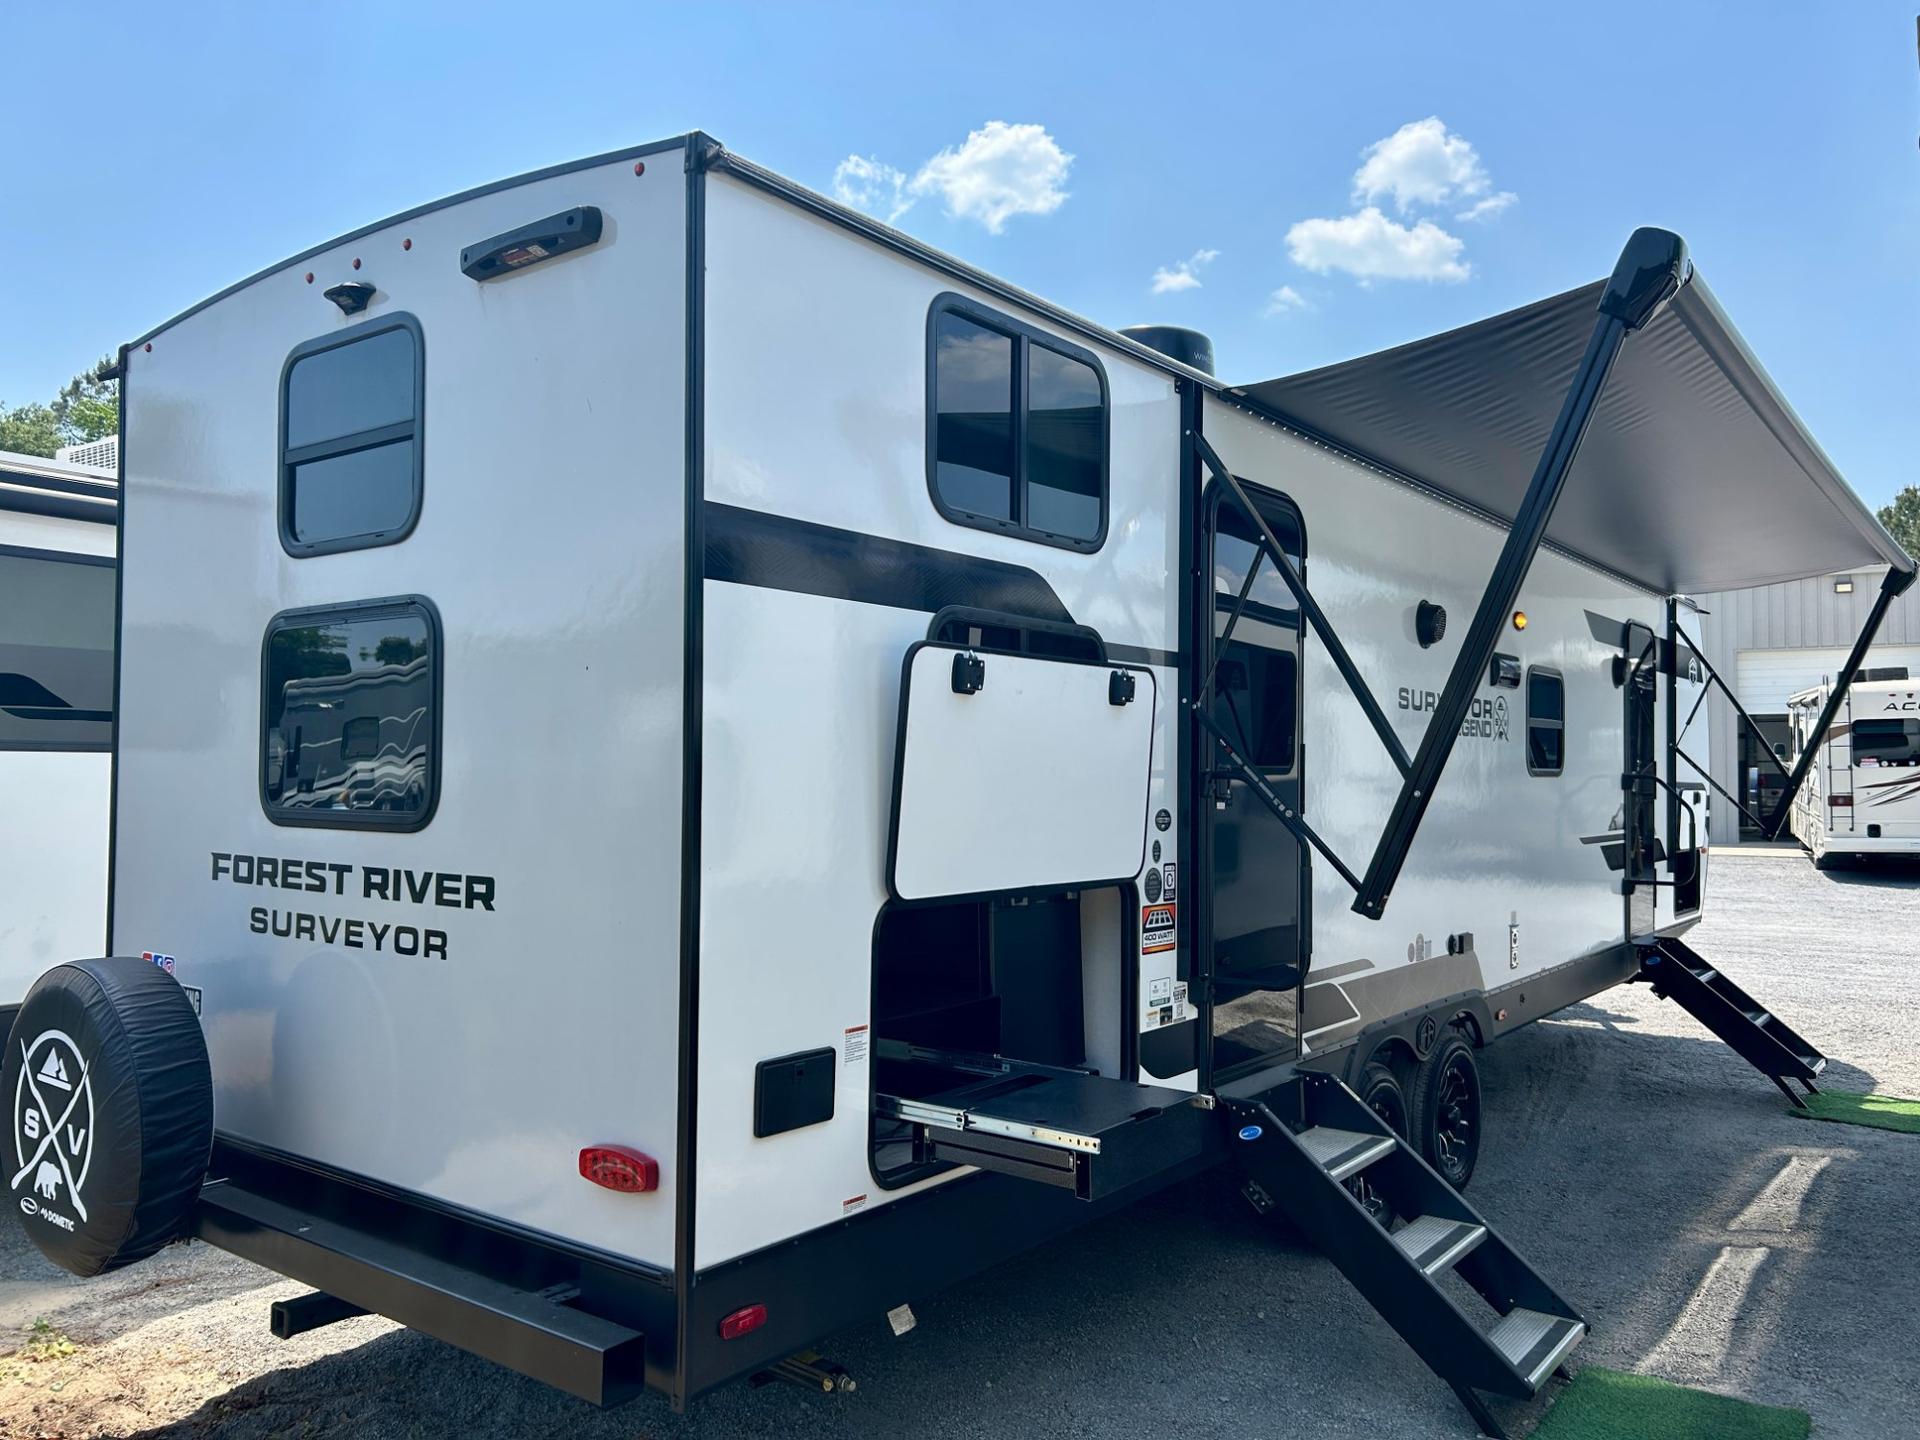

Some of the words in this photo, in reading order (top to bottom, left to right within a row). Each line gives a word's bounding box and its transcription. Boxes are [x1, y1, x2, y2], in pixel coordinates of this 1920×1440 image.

[1398, 687, 1492, 719] SUROR
[211, 852, 353, 895] FOREST
[362, 866, 496, 912] RIVER
[250, 907, 448, 960] SURVEYOR
[1144, 933, 1157, 941] 400
[1157, 930, 1174, 939] WATT
[24, 1107, 40, 1139] S
[67, 1123, 86, 1156] V
[47, 1210, 75, 1232] DOMETIC
